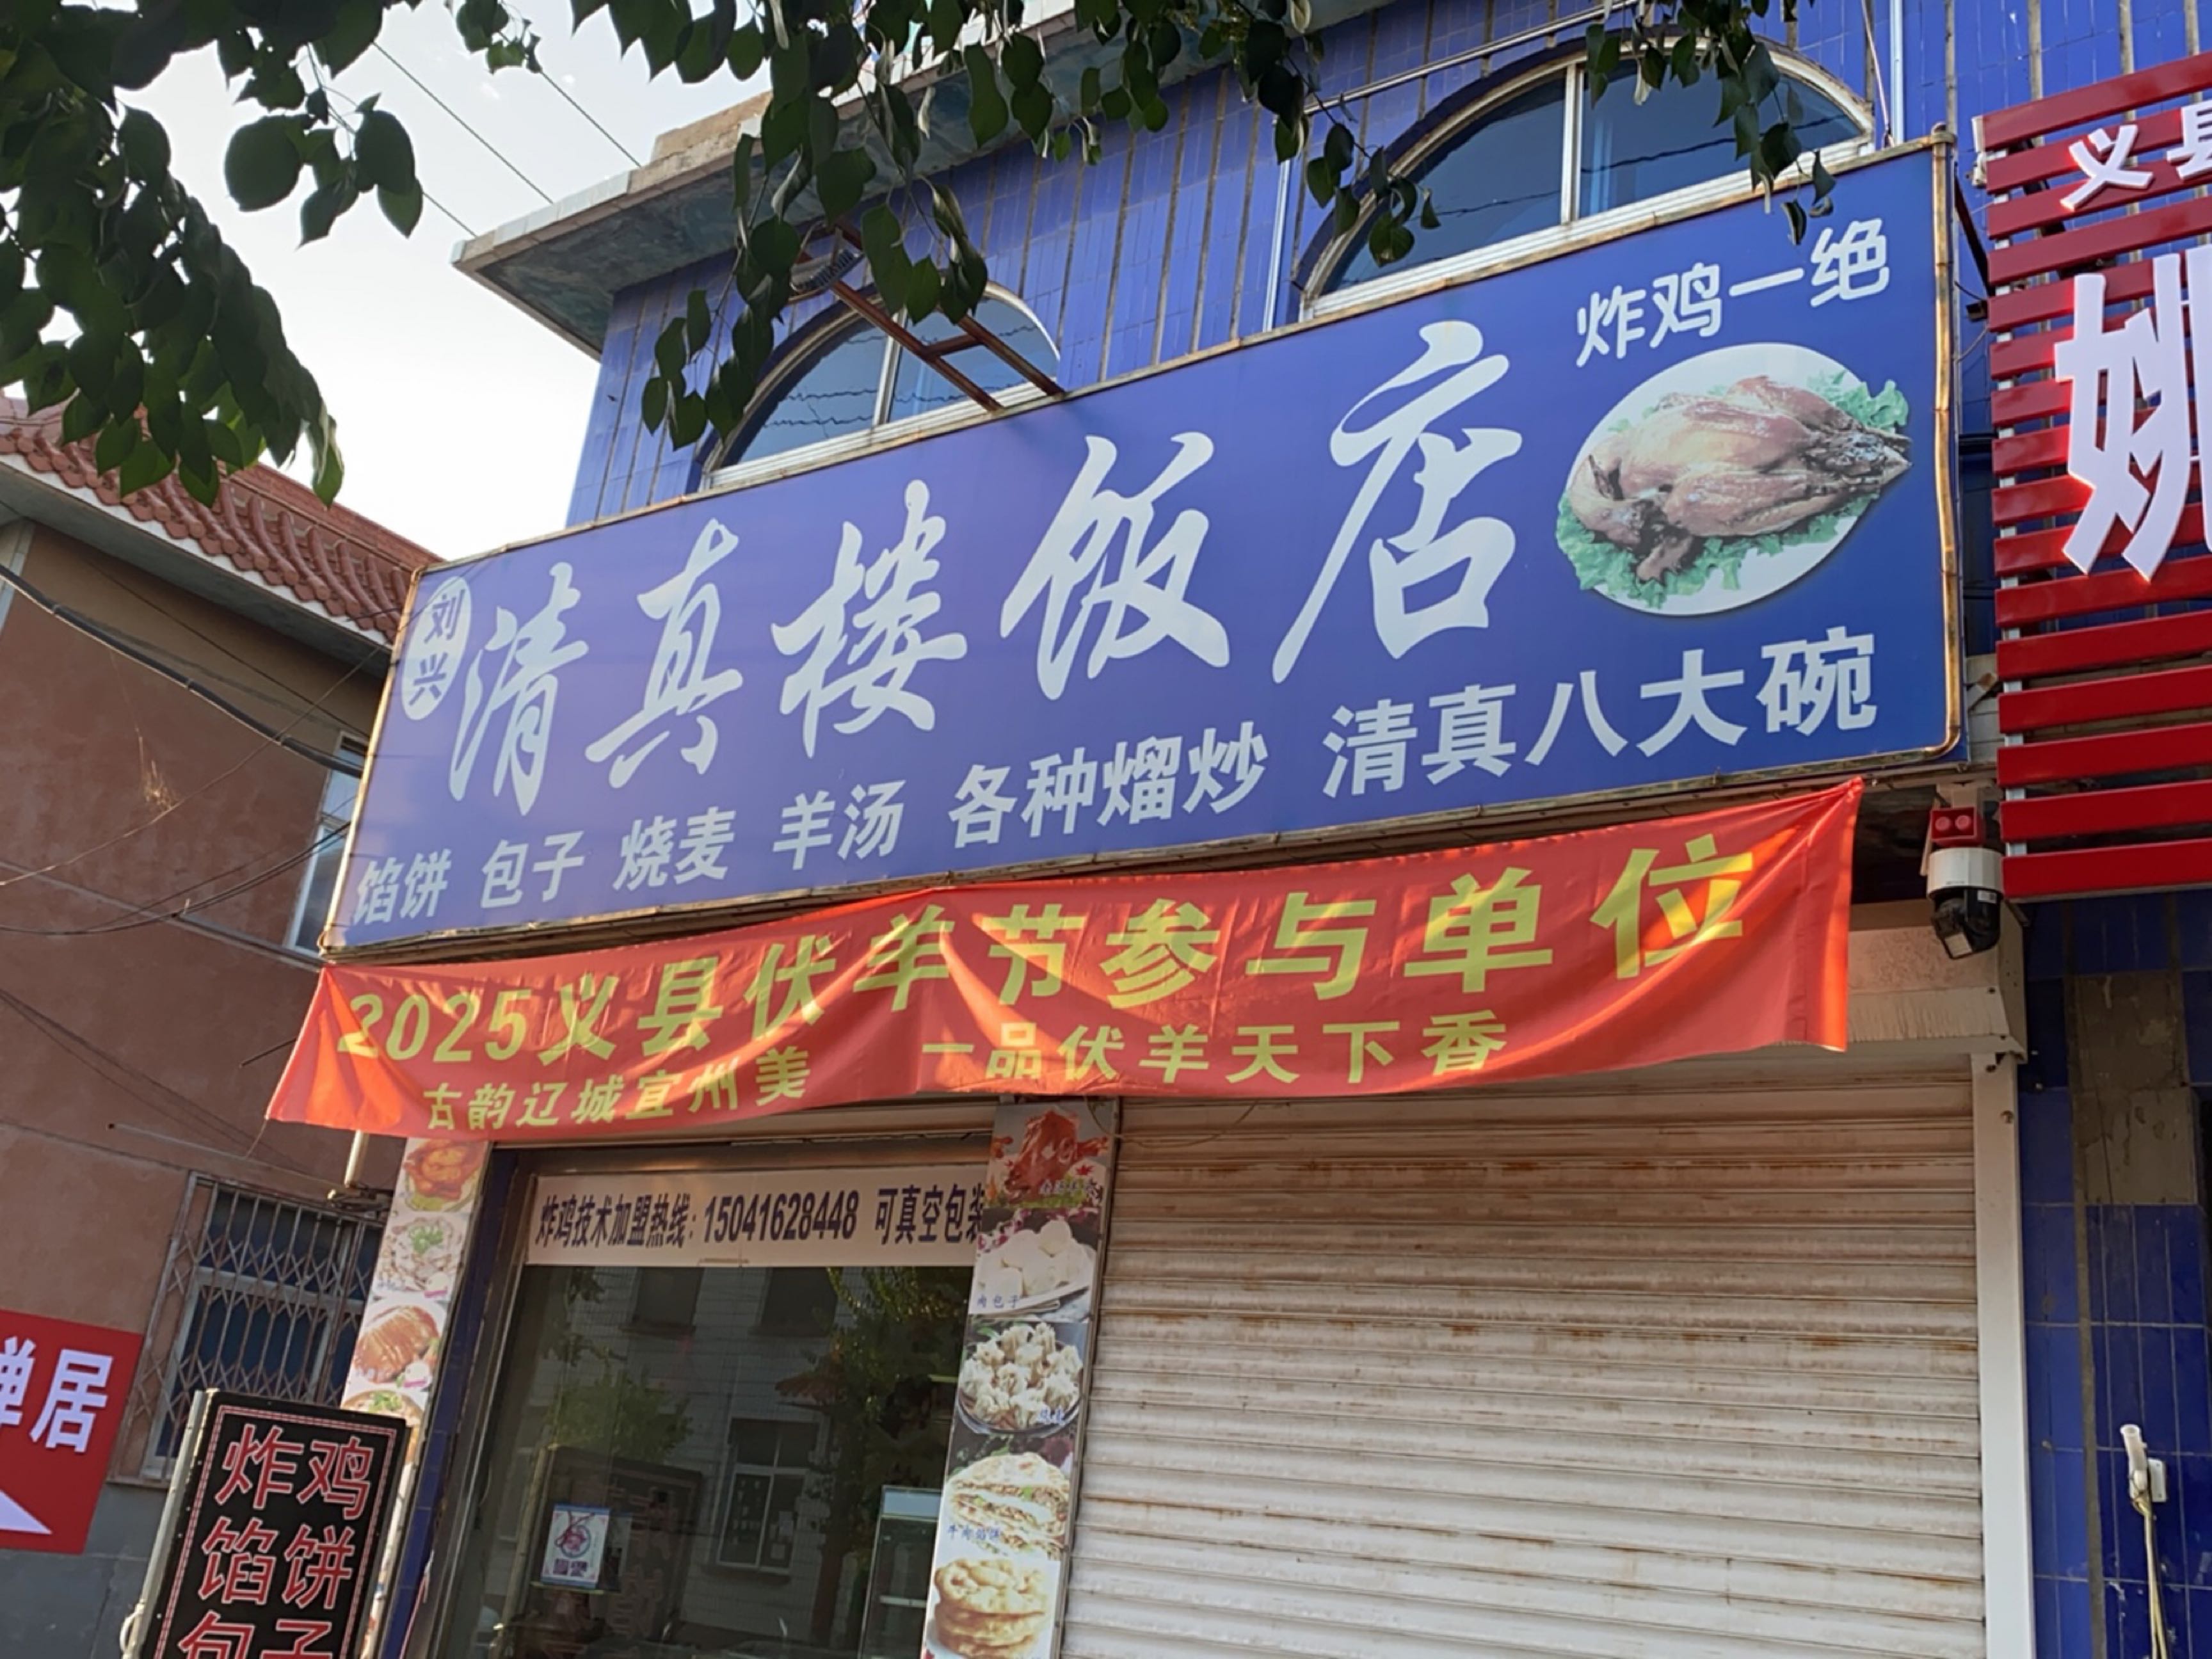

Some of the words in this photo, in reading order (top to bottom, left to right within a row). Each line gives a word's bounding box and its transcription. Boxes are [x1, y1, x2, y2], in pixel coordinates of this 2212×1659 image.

[1576, 218, 1890, 368] 炸鸡一绝
[449, 320, 1523, 817] 清真楼饭店
[408, 588, 466, 707] 刘兴
[353, 847, 452, 926] 馅饼
[481, 830, 585, 909] 包子
[613, 806, 736, 892] 烧麦
[772, 779, 906, 872] 羊汤
[947, 720, 1269, 850] 各种熘炒
[1321, 625, 1878, 800] 清真八大碗
[337, 832, 1756, 1066] 2025义县伏羊节参与单位
[422, 1043, 812, 1132] 古韵辽城宜州美
[920, 1008, 1509, 1089] 一品伏羊天下香
[703, 1189, 860, 1244] 15041628448
[213, 1422, 375, 1519] 炸鸡
[197, 1516, 356, 1610] 馅饼
